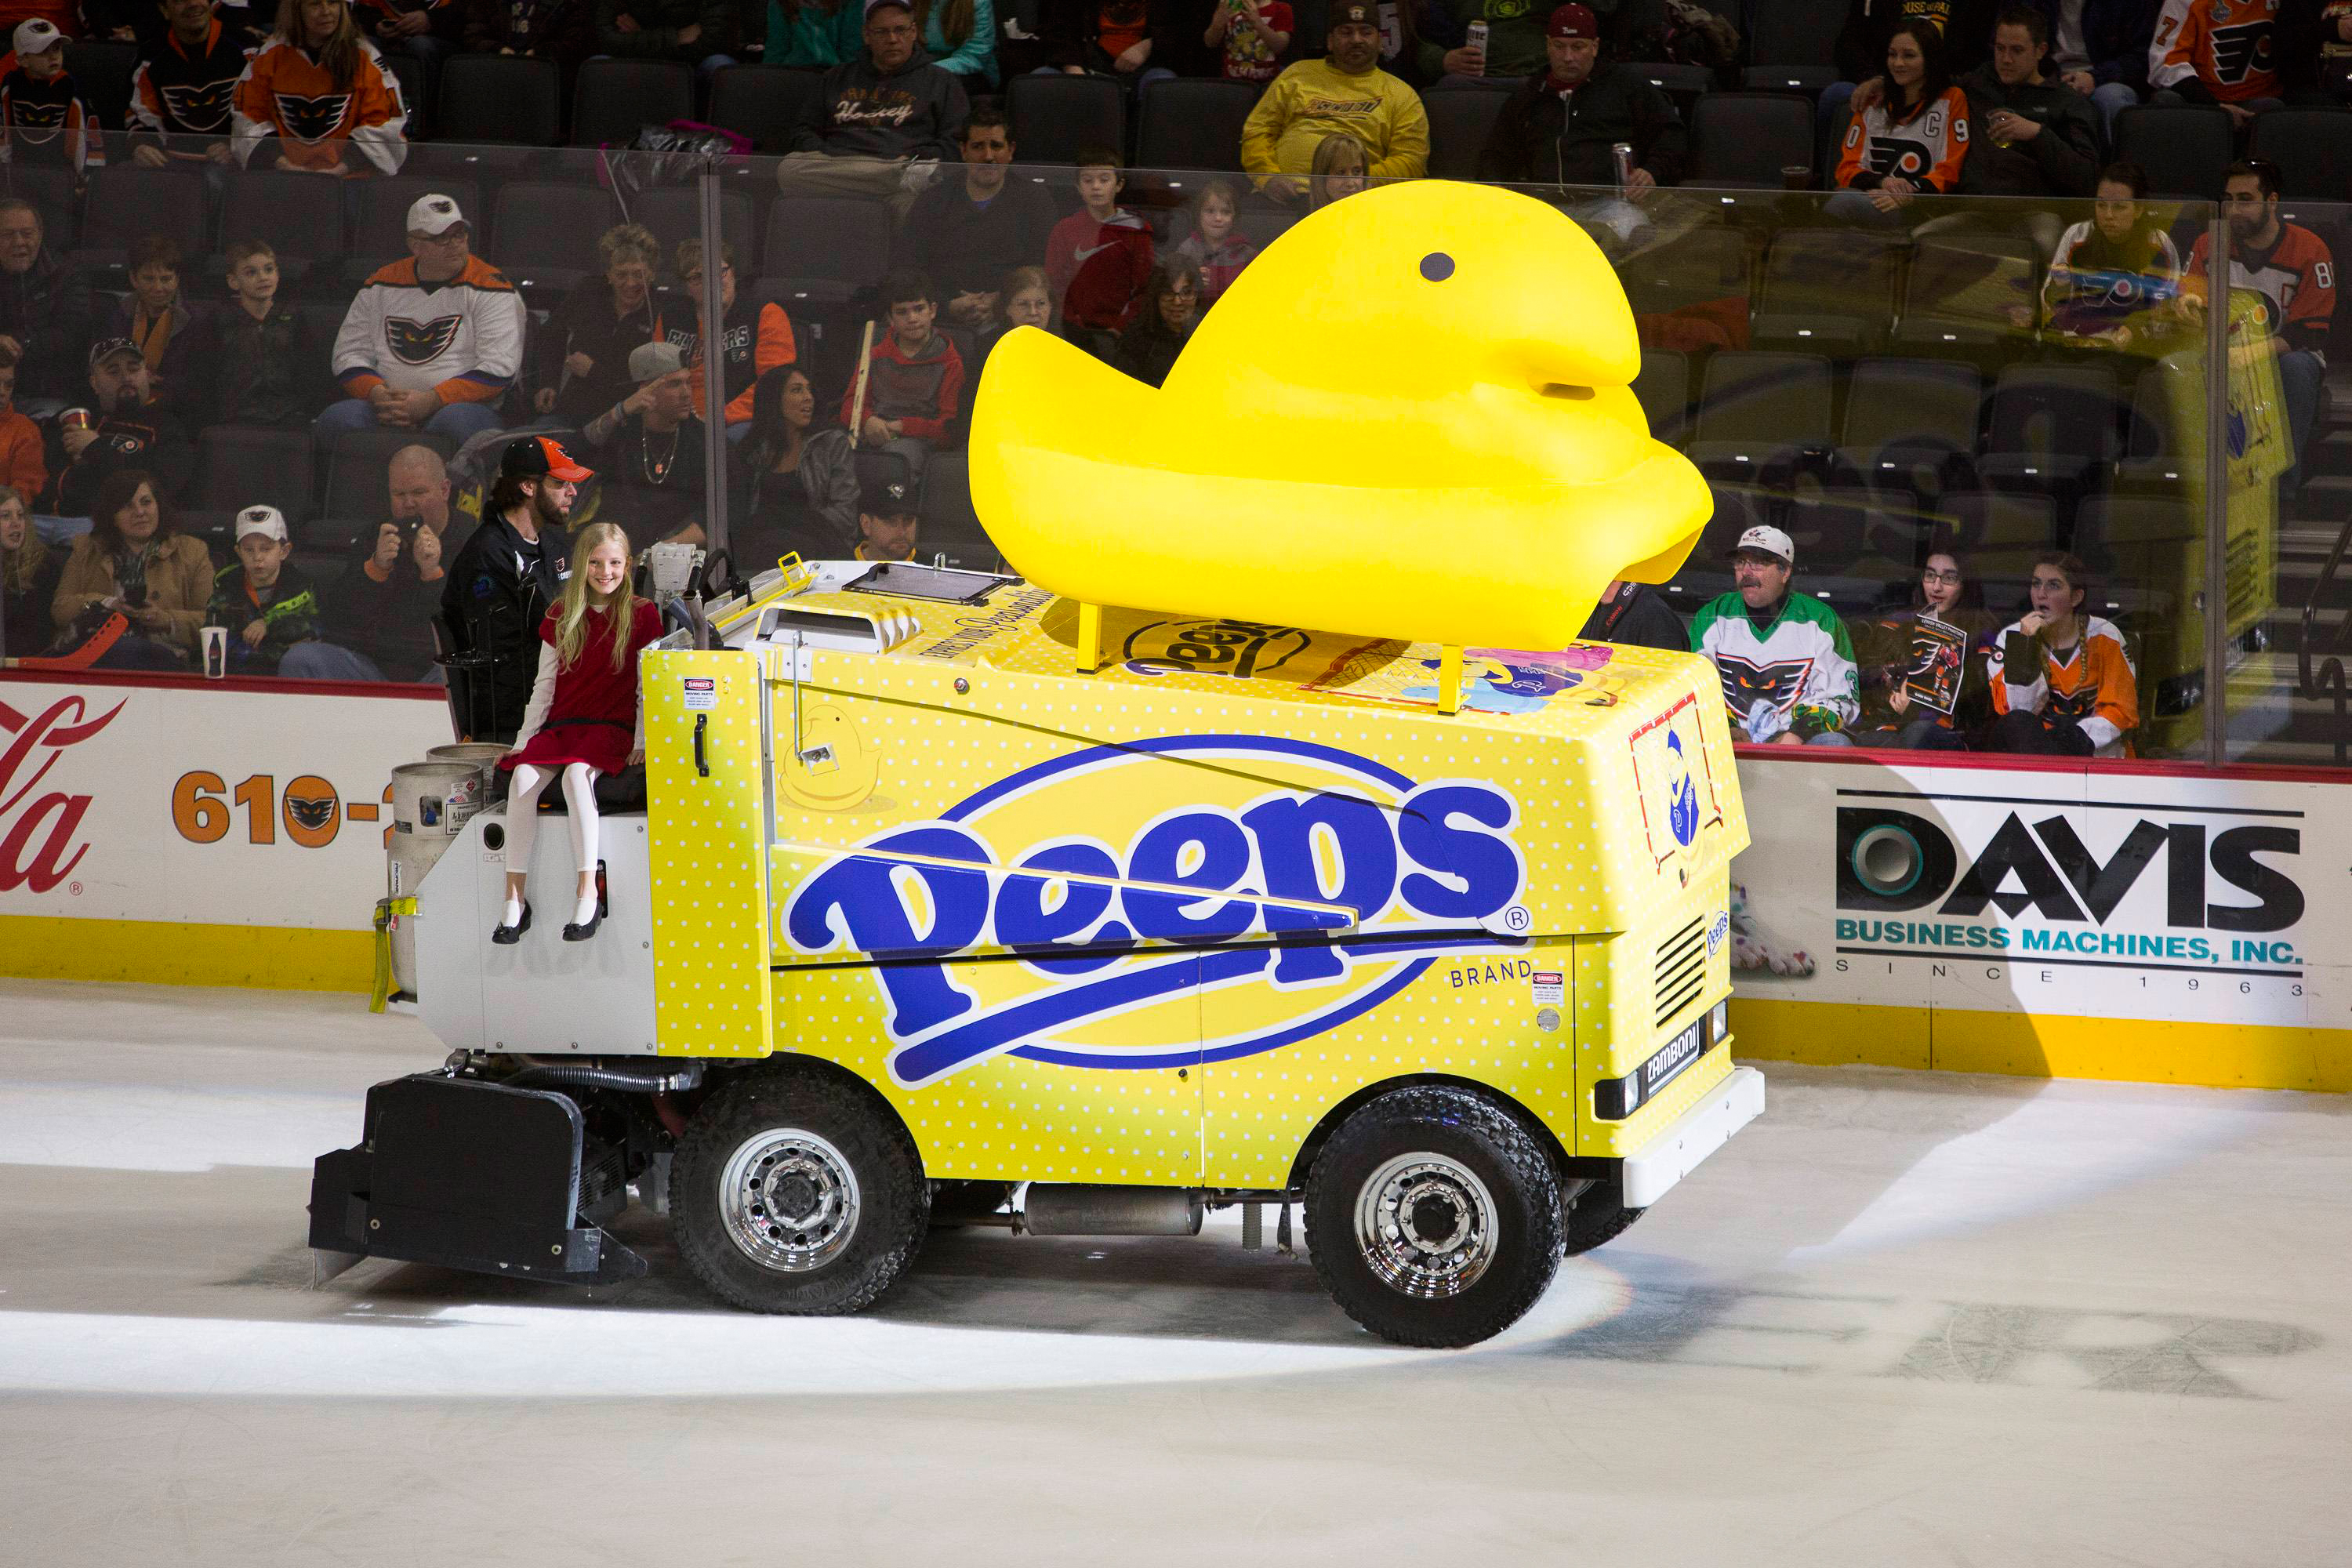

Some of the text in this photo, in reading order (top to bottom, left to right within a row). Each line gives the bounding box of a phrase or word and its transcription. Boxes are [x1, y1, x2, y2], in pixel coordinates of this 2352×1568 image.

[833, 100, 914, 125] Hockey
[1925, 111, 1941, 137] C
[173, 771, 394, 847] 610-
[1835, 806, 2305, 933] DAVIS
[787, 784, 1520, 1039] Peeps
[1707, 911, 1730, 954] Peeps
[1835, 919, 2303, 965] BUSINESS MACHINES, INC.
[1450, 960, 1532, 988] BRAND
[1835, 959, 2303, 997] SINCE 1963
[1647, 1025, 1697, 1081] ZAMBONI
